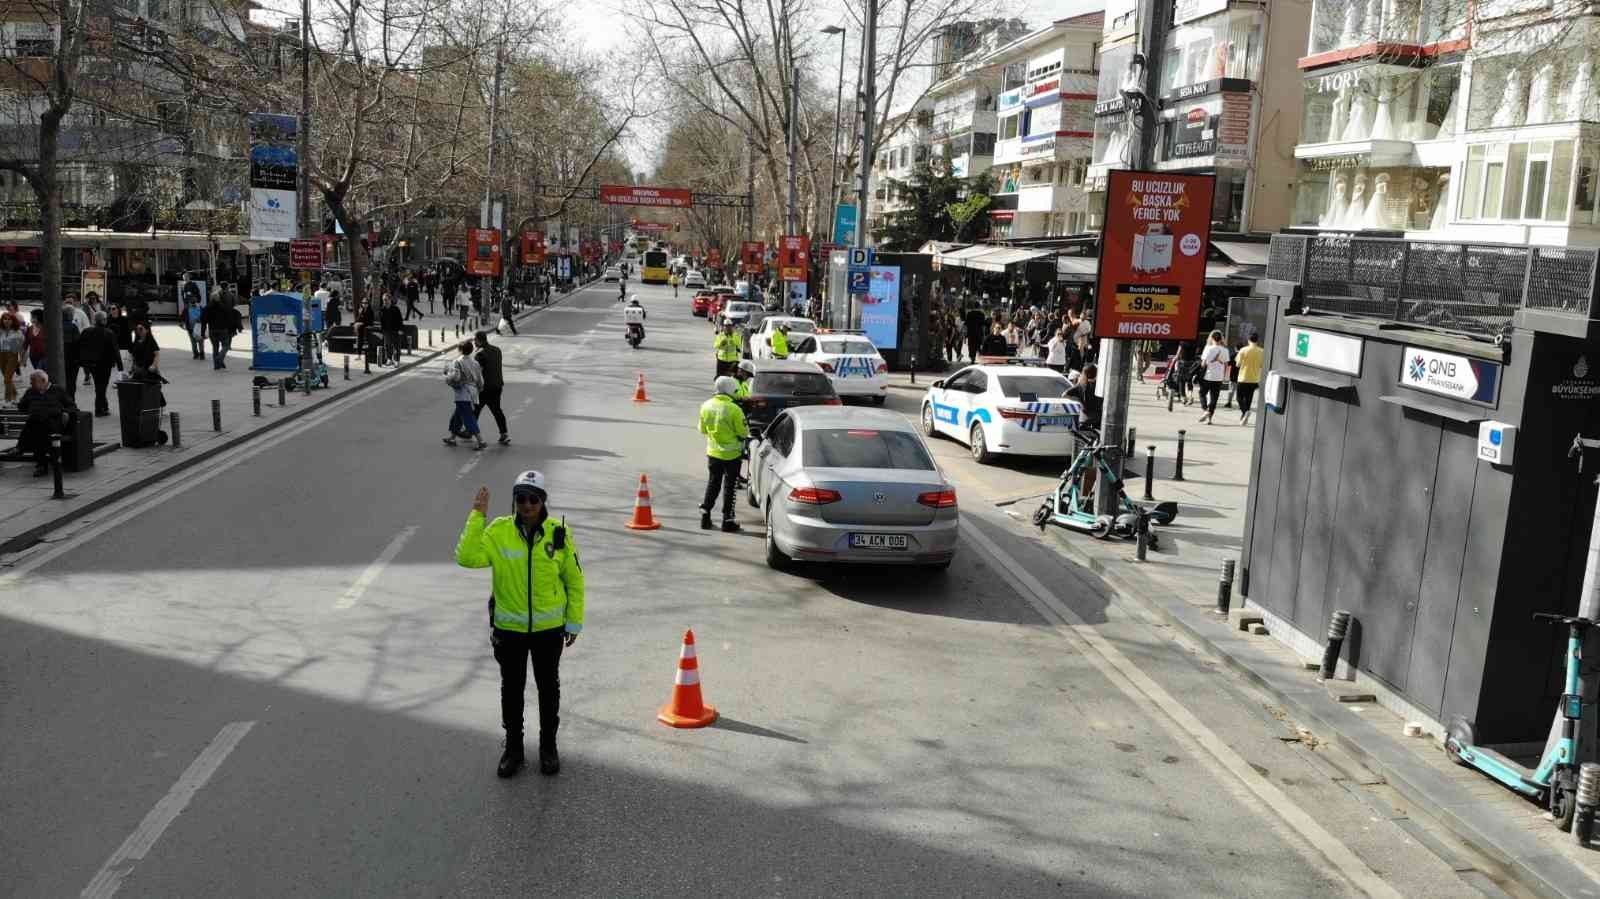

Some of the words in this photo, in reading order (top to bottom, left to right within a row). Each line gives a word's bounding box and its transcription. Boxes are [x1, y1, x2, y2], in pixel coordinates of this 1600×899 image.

[1318, 69, 1361, 93] IVORY
[1132, 180, 1144, 192] BU
[1145, 181, 1185, 194] UCUZLUK
[1132, 207, 1161, 220] YERDE
[1163, 209, 1181, 221] YOK
[854, 250, 865, 263] D
[1428, 358, 1457, 378] QNB
[855, 535, 866, 545] 34
